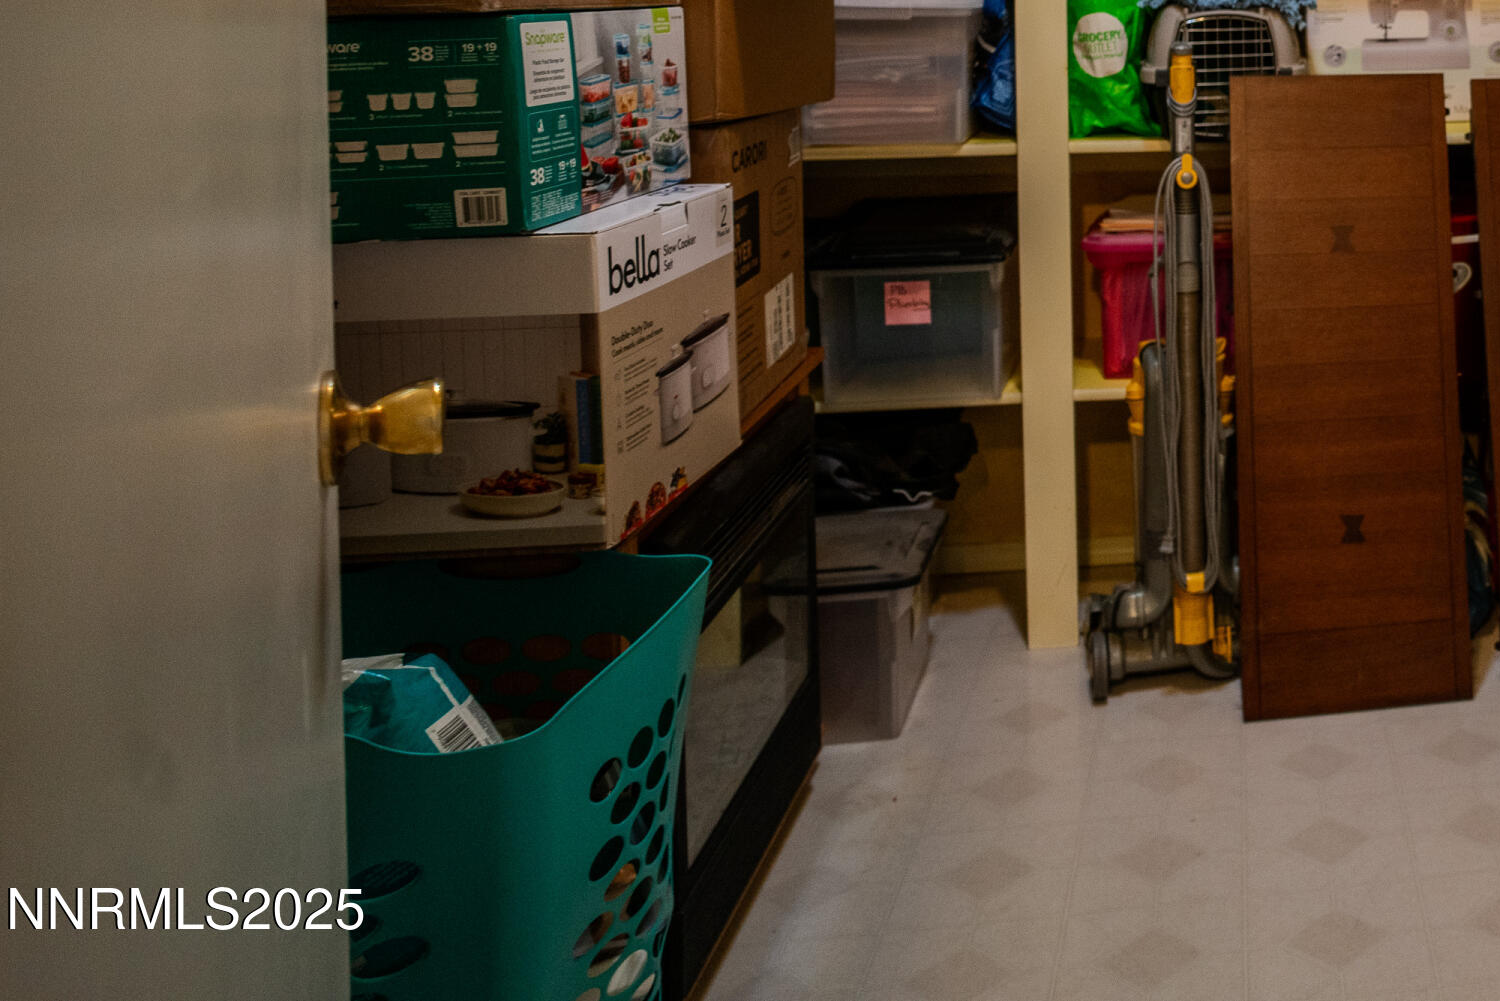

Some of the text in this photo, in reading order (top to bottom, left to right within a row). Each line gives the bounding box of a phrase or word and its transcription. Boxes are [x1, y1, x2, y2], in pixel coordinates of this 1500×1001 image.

[525, 31, 565, 47] Snapware
[1078, 29, 1122, 43] GROCERY
[328, 42, 360, 54] ware
[407, 46, 434, 62] 38
[461, 43, 475, 53] 19
[484, 41, 498, 52] 19
[530, 167, 545, 187] 38
[720, 204, 727, 228] 2
[663, 235, 697, 258] Slow Cooker
[608, 233, 662, 296] bella
[663, 258, 674, 272] Set
